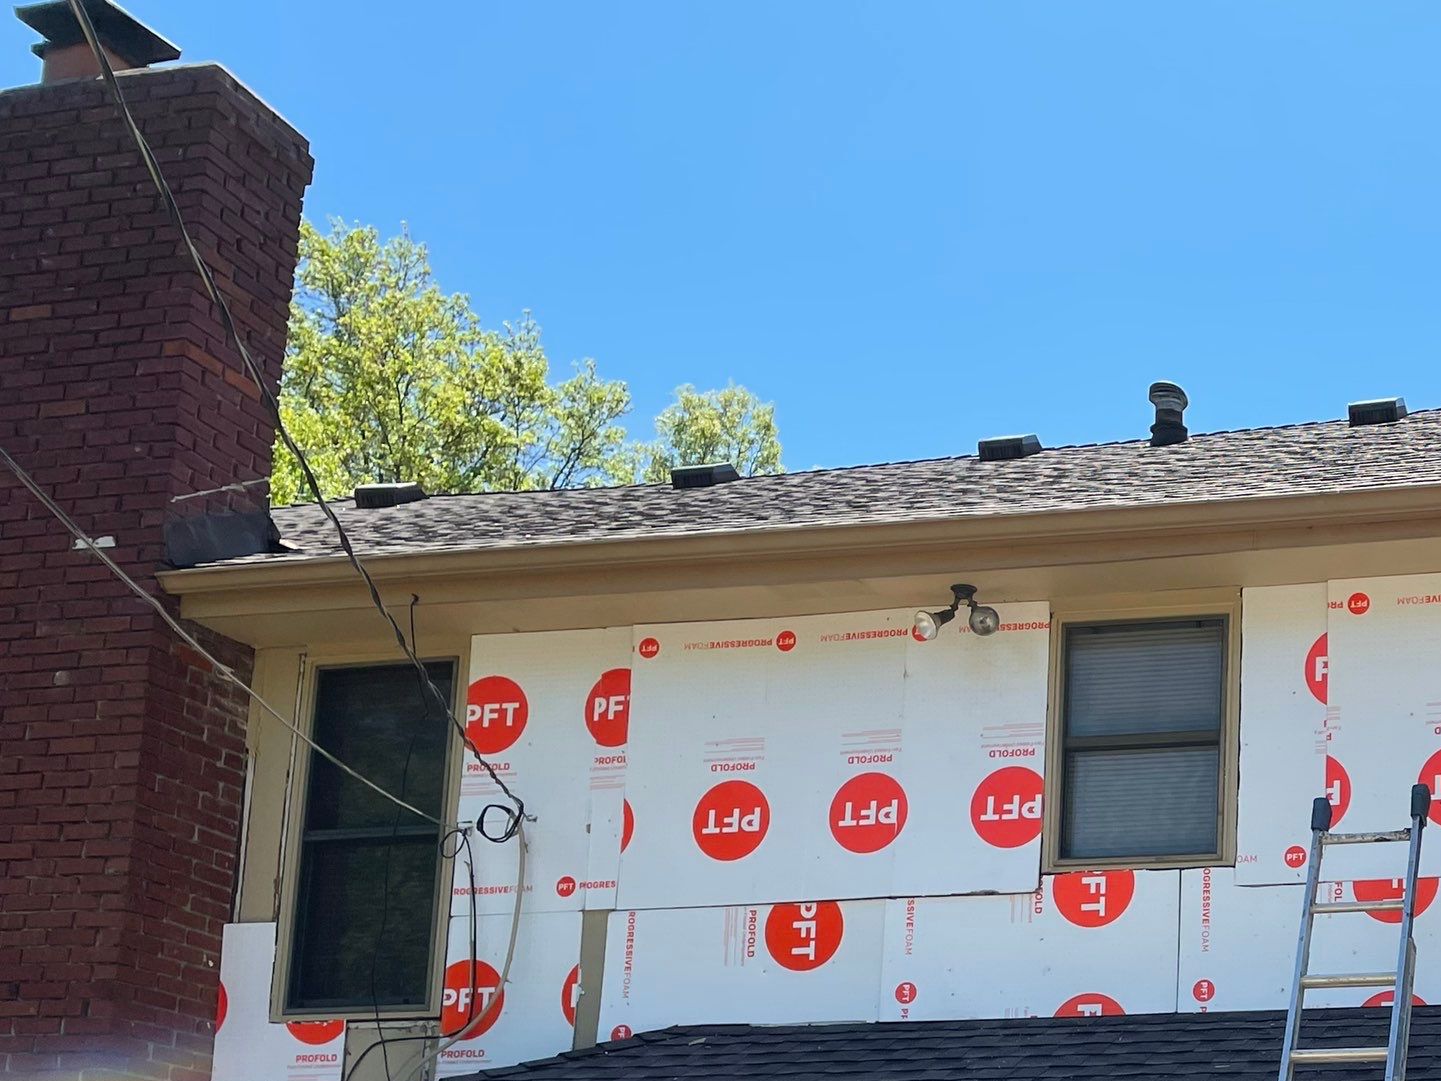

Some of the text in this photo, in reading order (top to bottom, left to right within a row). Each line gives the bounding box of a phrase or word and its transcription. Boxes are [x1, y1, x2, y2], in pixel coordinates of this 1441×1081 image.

[1350, 599, 1369, 609] PFT
[820, 628, 909, 642] PROGRESSIVEFOAM
[684, 638, 773, 650] PROGRESSIVEFOAM
[777, 638, 796, 646] PFT
[641, 645, 659, 653] PFT
[593, 695, 630, 722] PF
[466, 702, 520, 728] PFT
[988, 748, 1036, 758] PROFOLD
[847, 754, 893, 765] PROFOLD
[710, 763, 756, 772] PROFOLD
[838, 799, 899, 827] PFT
[979, 794, 1043, 821] PFT
[701, 807, 761, 834] PFT
[1286, 853, 1305, 862] PFT
[453, 884, 533, 896] ROGRESSIVEFAM
[558, 882, 574, 891] PFT
[1080, 868, 1107, 917] FT
[790, 903, 818, 961] PFT
[904, 897, 915, 956] SSIVEFOAM
[747, 909, 757, 958] PROFOLD
[295, 1053, 338, 1063] PROFOLD
[440, 1050, 485, 1059] PROFOLD
